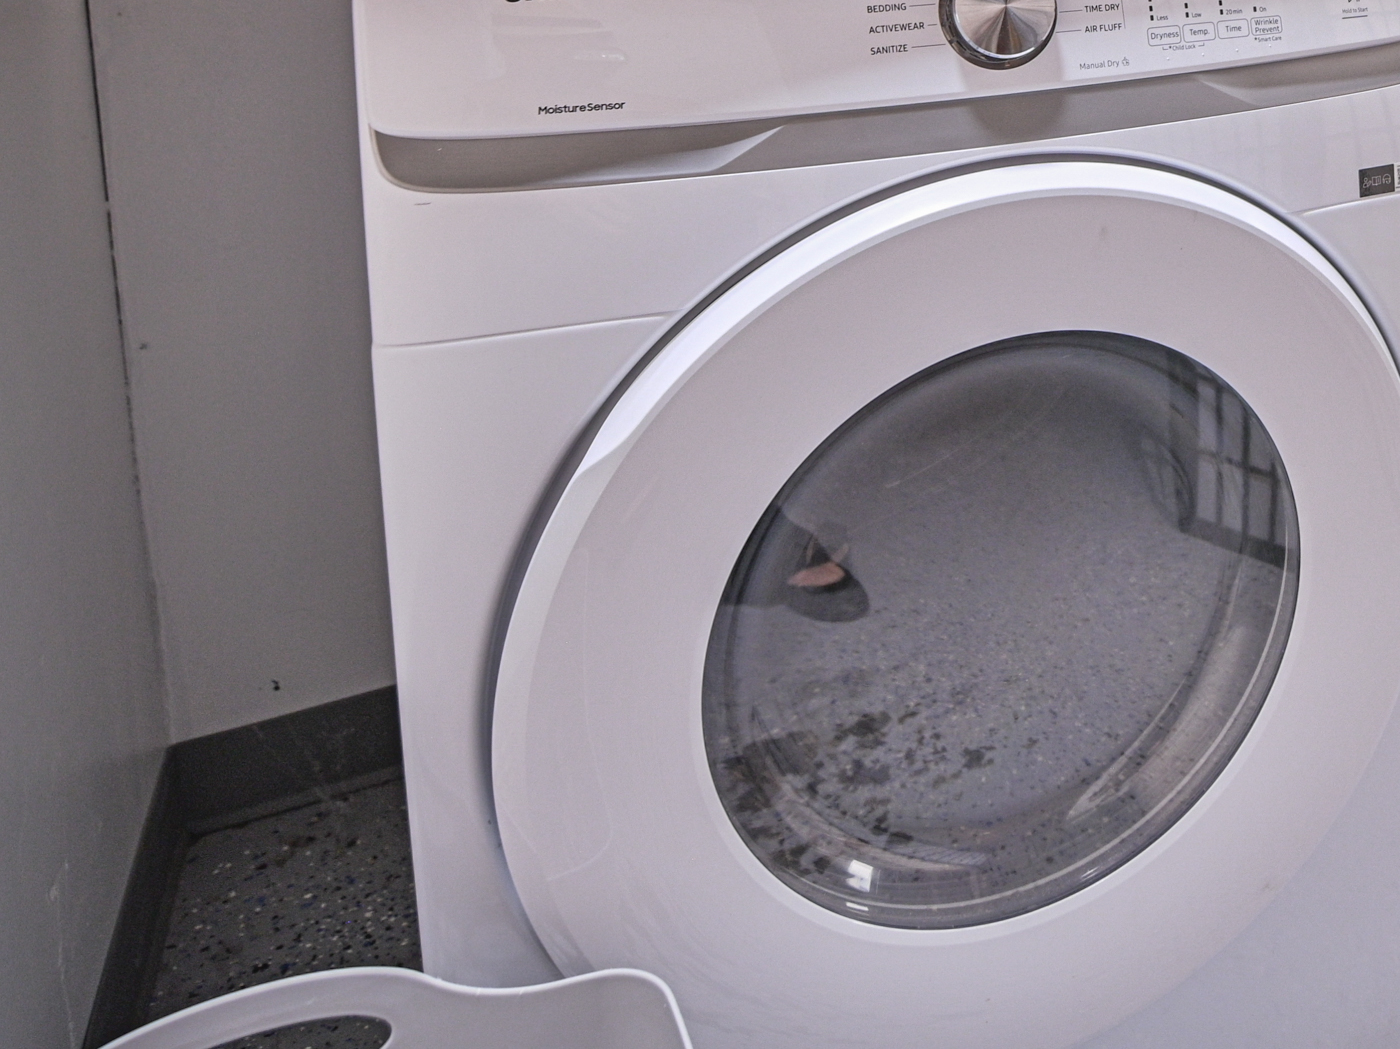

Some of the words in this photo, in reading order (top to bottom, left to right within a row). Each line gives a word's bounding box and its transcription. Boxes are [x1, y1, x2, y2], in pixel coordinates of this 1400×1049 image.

[867, 3, 907, 14] BEDDING
[1084, 4, 1103, 13] TIME
[1104, 3, 1120, 12] DRY
[1254, 17, 1279, 26] Wrinkle
[868, 22, 925, 34] ACTIVEWEAR
[1084, 24, 1098, 33] AIR
[1099, 23, 1123, 32] FLUFF
[1189, 28, 1211, 36] Temp.
[1225, 25, 1242, 33] Time
[1254, 25, 1280, 34] Prevent
[1150, 31, 1179, 41] Dryness
[870, 44, 909, 55] SANITIZE
[1079, 60, 1106, 71] Manual
[1107, 58, 1120, 68] Dry
[537, 101, 626, 116] MoistureSensor
